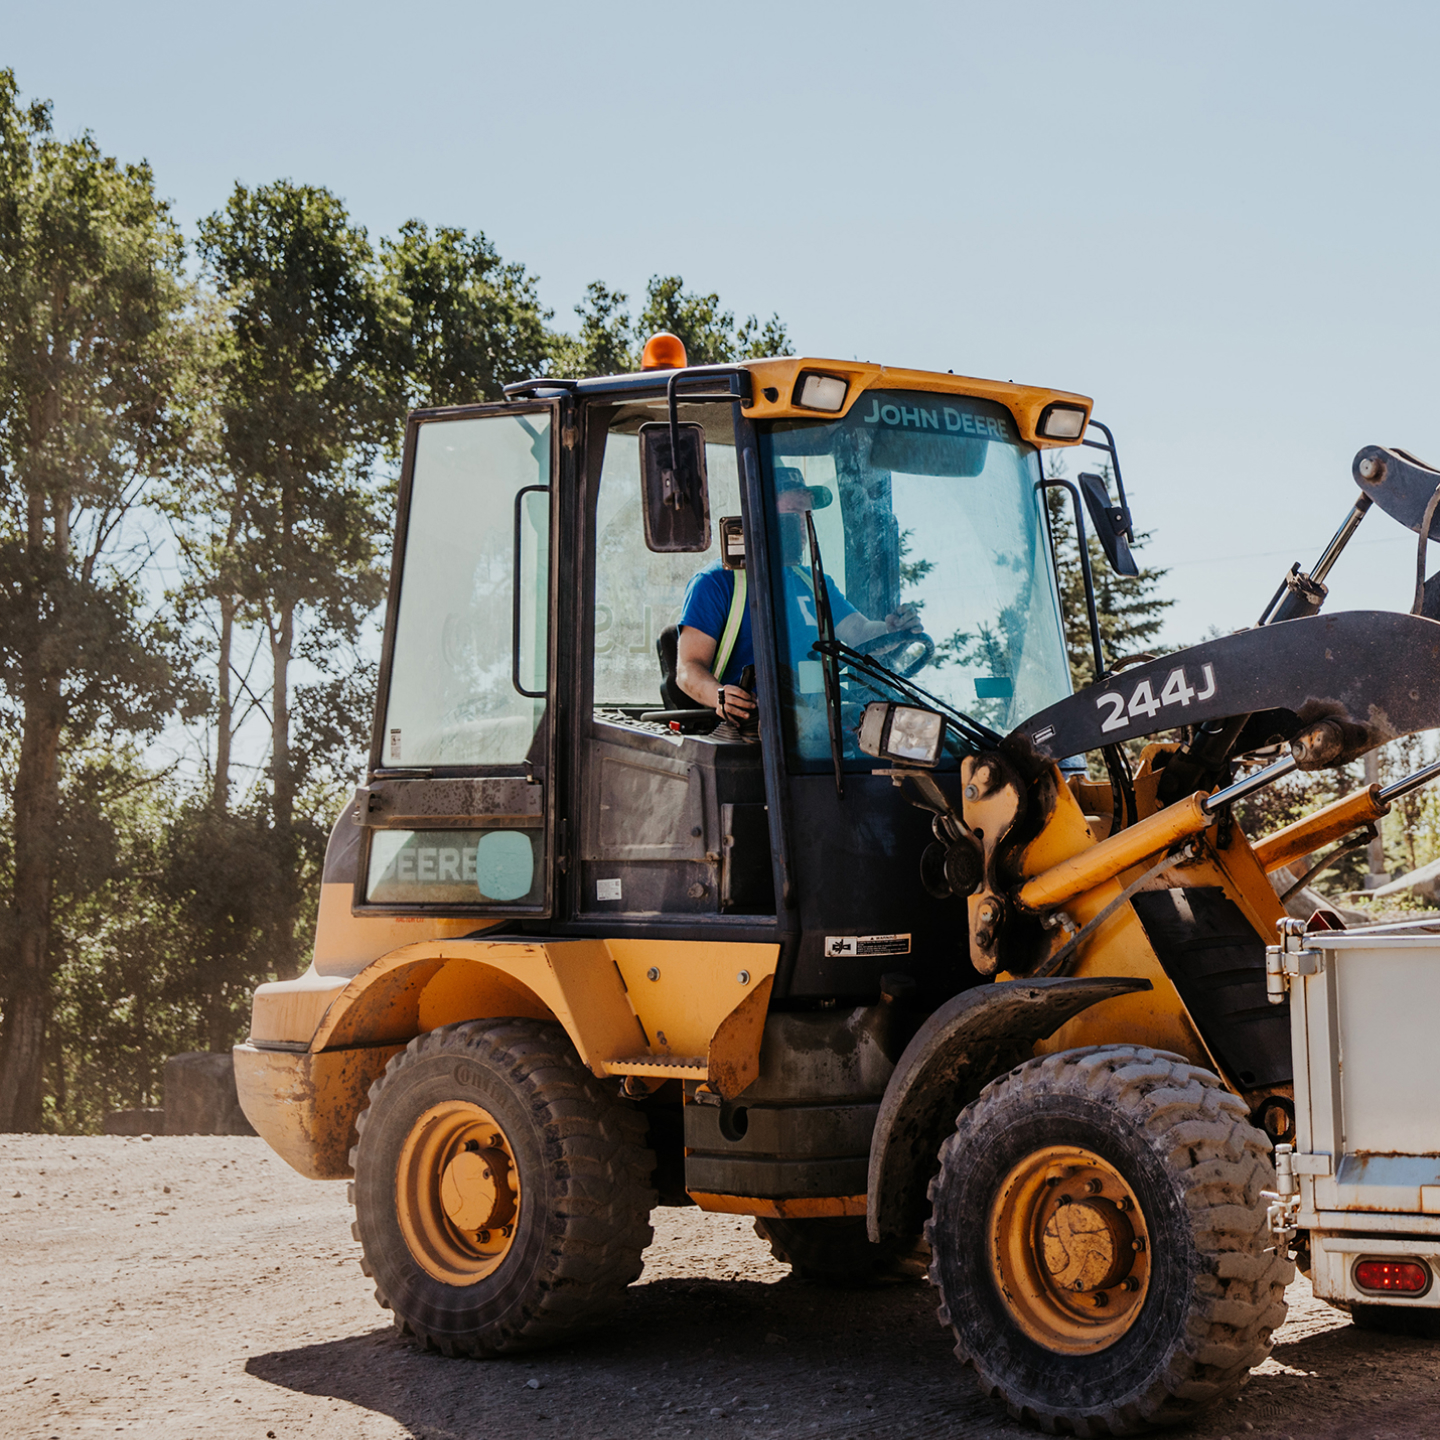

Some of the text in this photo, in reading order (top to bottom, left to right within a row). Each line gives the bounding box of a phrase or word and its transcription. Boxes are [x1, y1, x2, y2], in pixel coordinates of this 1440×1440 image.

[864, 399, 1009, 439] JOHN DEERE
[1096, 665, 1216, 733] 244J
